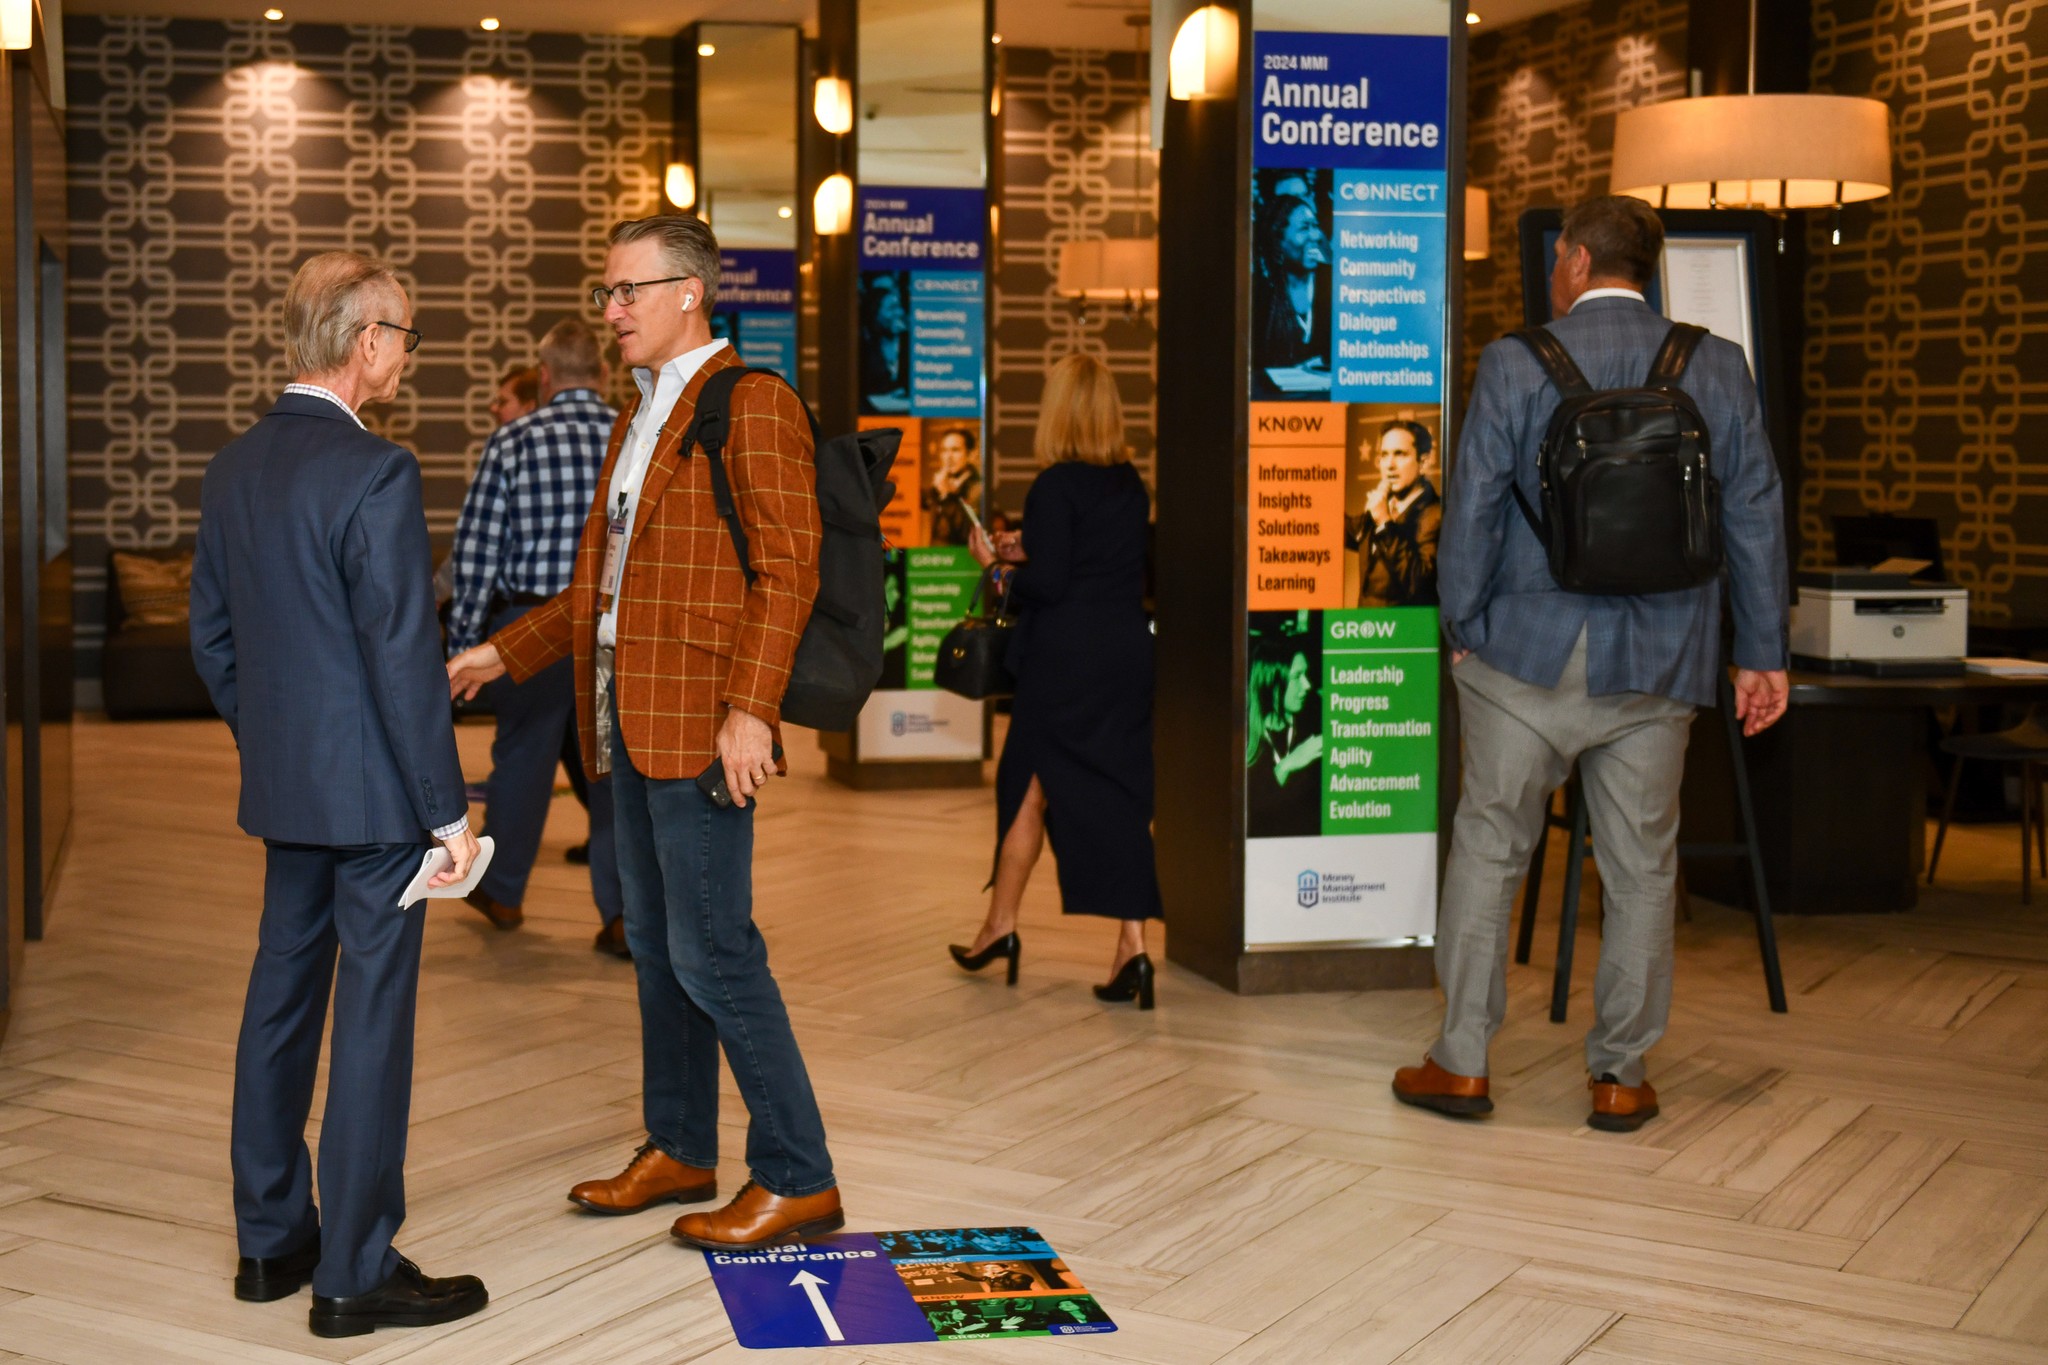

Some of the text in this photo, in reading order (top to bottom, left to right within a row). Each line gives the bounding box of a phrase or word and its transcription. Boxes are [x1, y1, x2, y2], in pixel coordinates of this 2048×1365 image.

[1263, 54, 1328, 71] 2024 MMI
[1262, 74, 1369, 109] Annual
[1261, 111, 1439, 148] Conference
[1340, 182, 1439, 201] CONNECT
[863, 211, 934, 234] Annual
[863, 235, 980, 259] Conference
[1340, 229, 1418, 253] Networking
[1339, 257, 1416, 280] Community
[1339, 285, 1426, 307] Perspectives
[1339, 312, 1397, 335] Dialogue
[1338, 339, 1430, 362] Relationships
[1338, 366, 1433, 386] Conversations
[1258, 416, 1323, 432] KNOW
[1258, 464, 1337, 481] Information
[1258, 491, 1312, 513] Insights
[1258, 518, 1320, 536] Solutions
[1258, 546, 1331, 566] Takeaways
[1257, 574, 1316, 594] Learning
[1330, 620, 1396, 639] GROW
[1330, 665, 1404, 686] Leadership
[1330, 693, 1389, 715] Progress
[1330, 719, 1431, 738] Transformation
[1330, 747, 1373, 769] Agility
[1330, 773, 1420, 792] Advancement
[1329, 800, 1391, 819] Evolution
[713, 1250, 877, 1265] Conference
